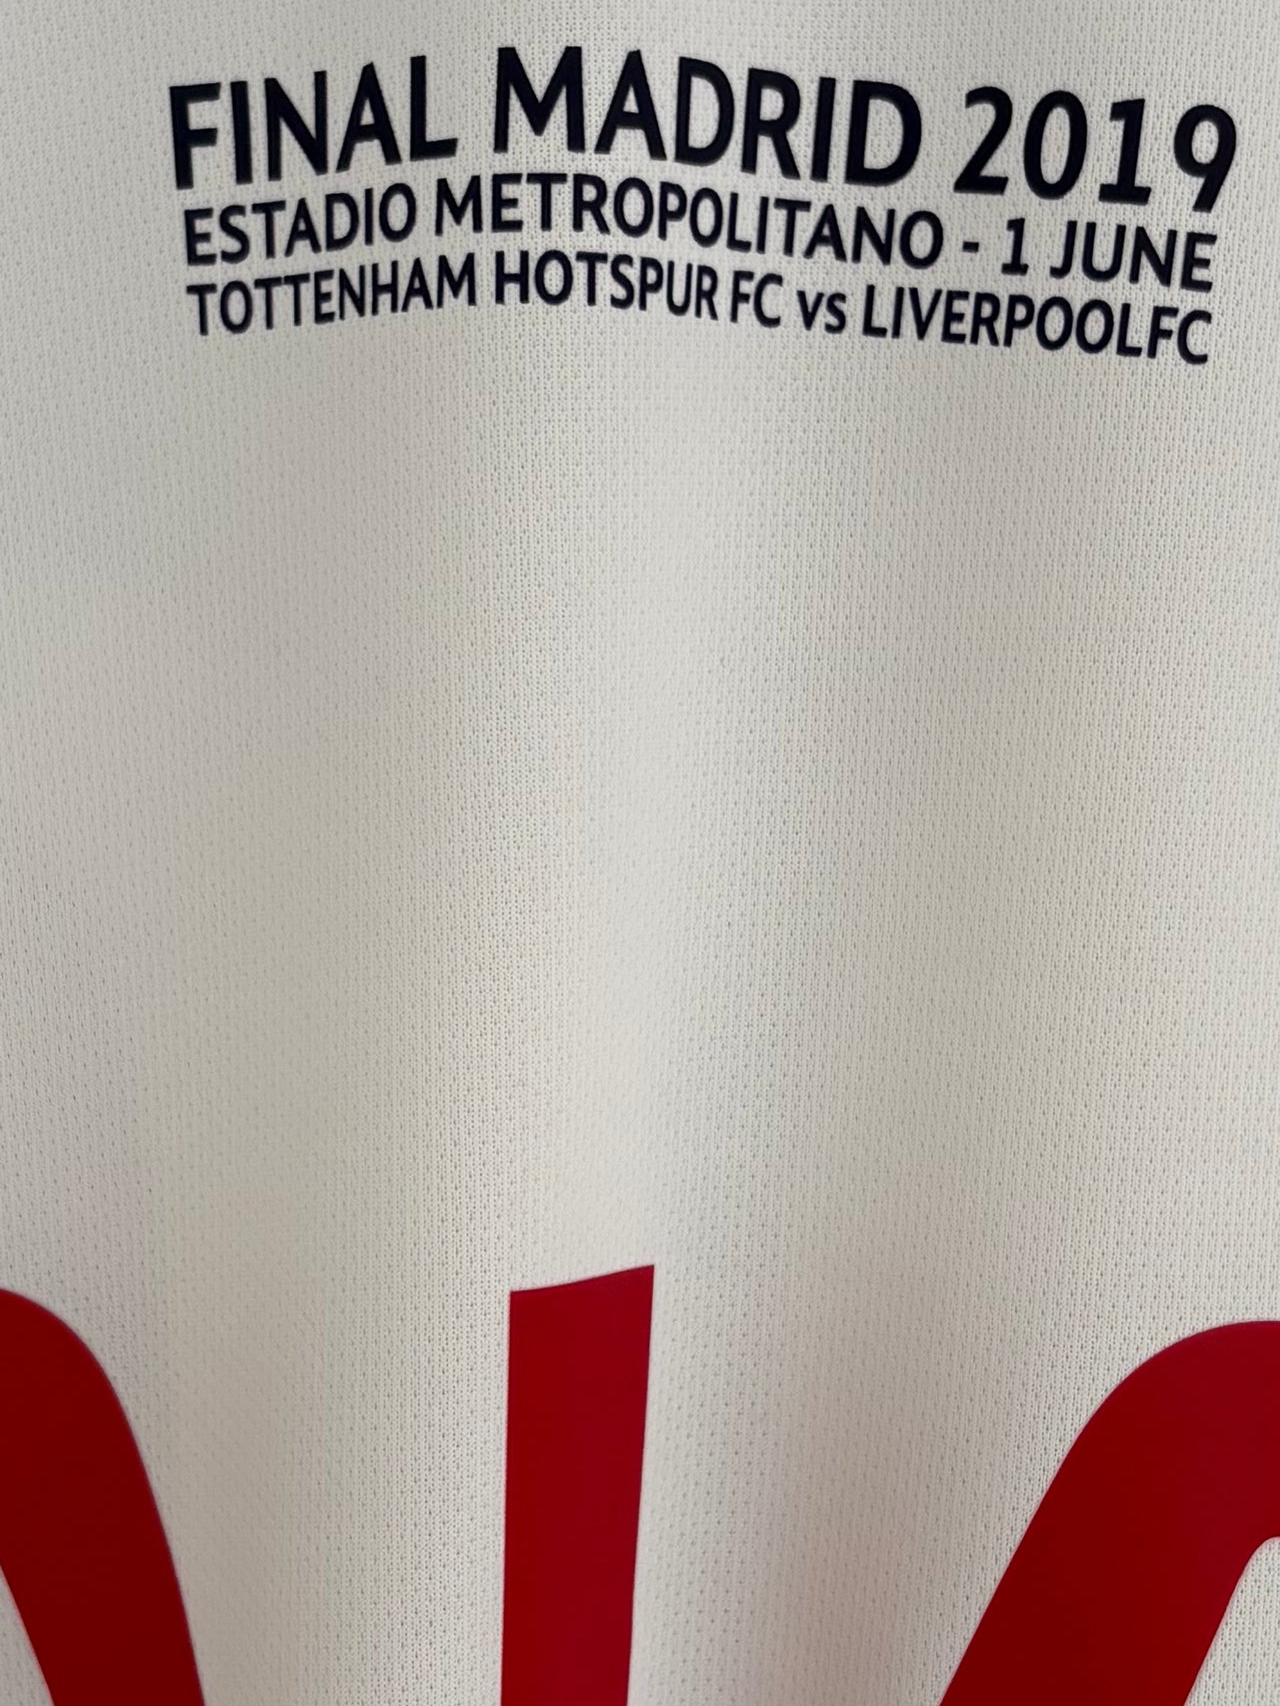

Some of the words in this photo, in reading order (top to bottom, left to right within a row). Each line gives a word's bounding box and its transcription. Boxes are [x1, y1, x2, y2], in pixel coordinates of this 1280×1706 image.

[168, 54, 459, 191] FINAL
[492, 45, 923, 188] MADRID
[952, 85, 1237, 214] 2019
[183, 182, 418, 267] ESTADIO
[434, 171, 945, 270] METROPOLITANO
[1000, 216, 1030, 277] 1
[1049, 219, 1218, 294] JUNE
[185, 252, 477, 336] TOTTENHAM
[494, 249, 719, 321] HOTSPUR
[730, 270, 784, 329] FC
[796, 290, 847, 335] vs
